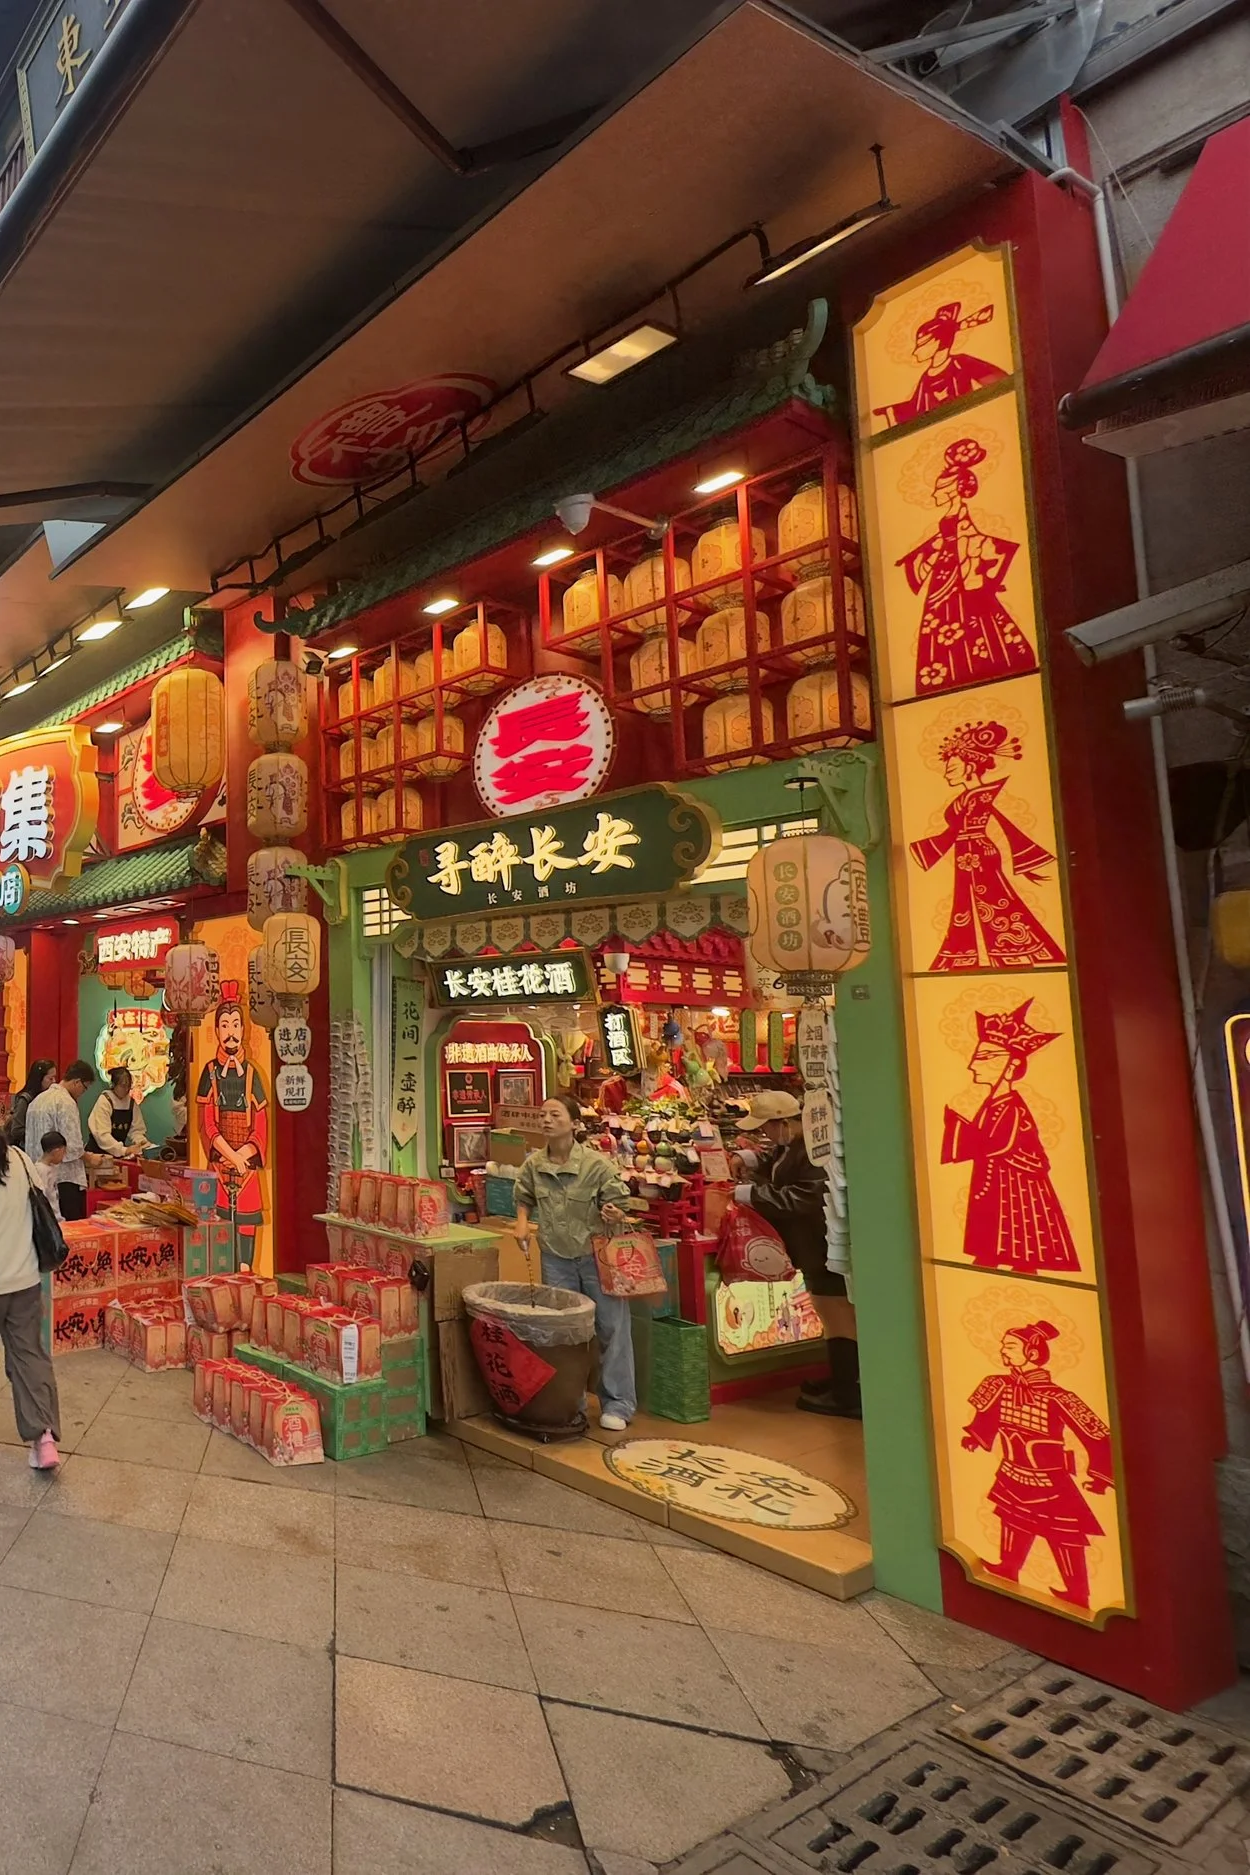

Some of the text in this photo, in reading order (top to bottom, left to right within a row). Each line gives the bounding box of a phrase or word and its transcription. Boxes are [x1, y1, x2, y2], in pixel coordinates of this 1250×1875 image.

[427, 812, 640, 895] 寻醉长安
[487, 882, 577, 905] 长安酒坊
[775, 862, 801, 949] 长安酒坊
[98, 927, 172, 963] 西安特产
[282, 930, 311, 982] 長安
[443, 962, 577, 998] 长安桂花酒
[279, 1027, 307, 1041] 进店
[280, 1043, 306, 1057] 试喝
[604, 1013, 634, 1066] 打酒区
[805, 1025, 823, 1041] 全国
[397, 1001, 420, 1116] 花间一壶醉
[444, 1042, 534, 1064] 非遗酒曲传承人
[285, 1075, 305, 1086] 新鲜
[285, 1087, 305, 1097] 现打
[481, 1321, 521, 1405] 桂花酒
[667, 1449, 818, 1498] 长安
